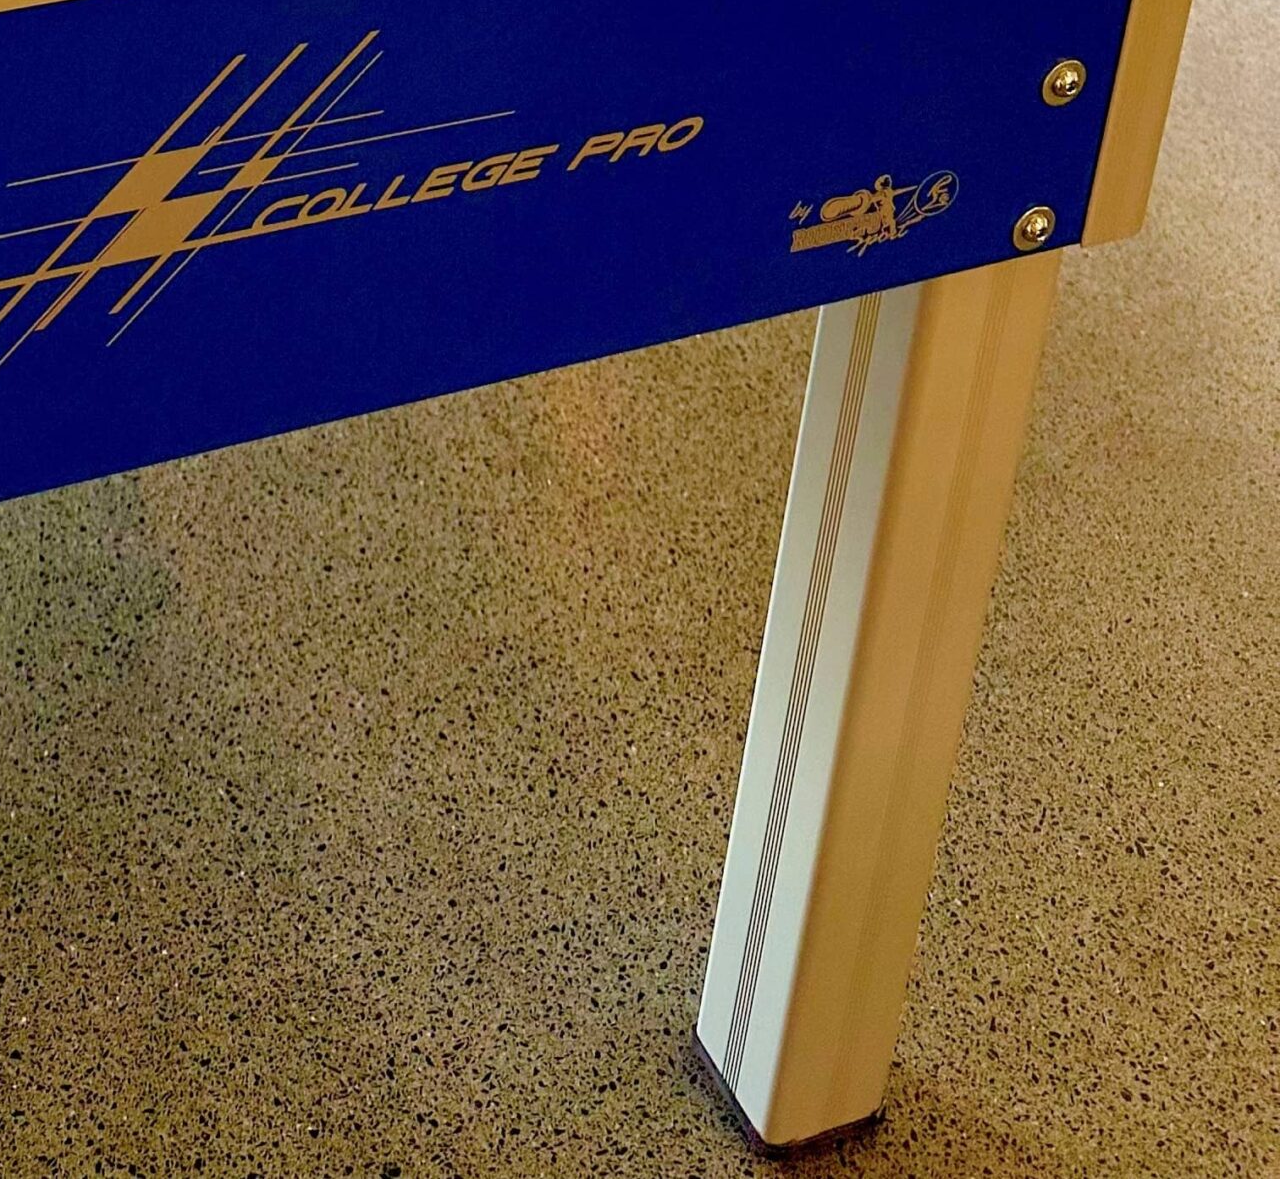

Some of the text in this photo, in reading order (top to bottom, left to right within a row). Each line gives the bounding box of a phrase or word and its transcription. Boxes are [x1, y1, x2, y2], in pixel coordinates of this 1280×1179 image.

[252, 116, 704, 231] COLLEGE PRO
[788, 201, 813, 224] by
